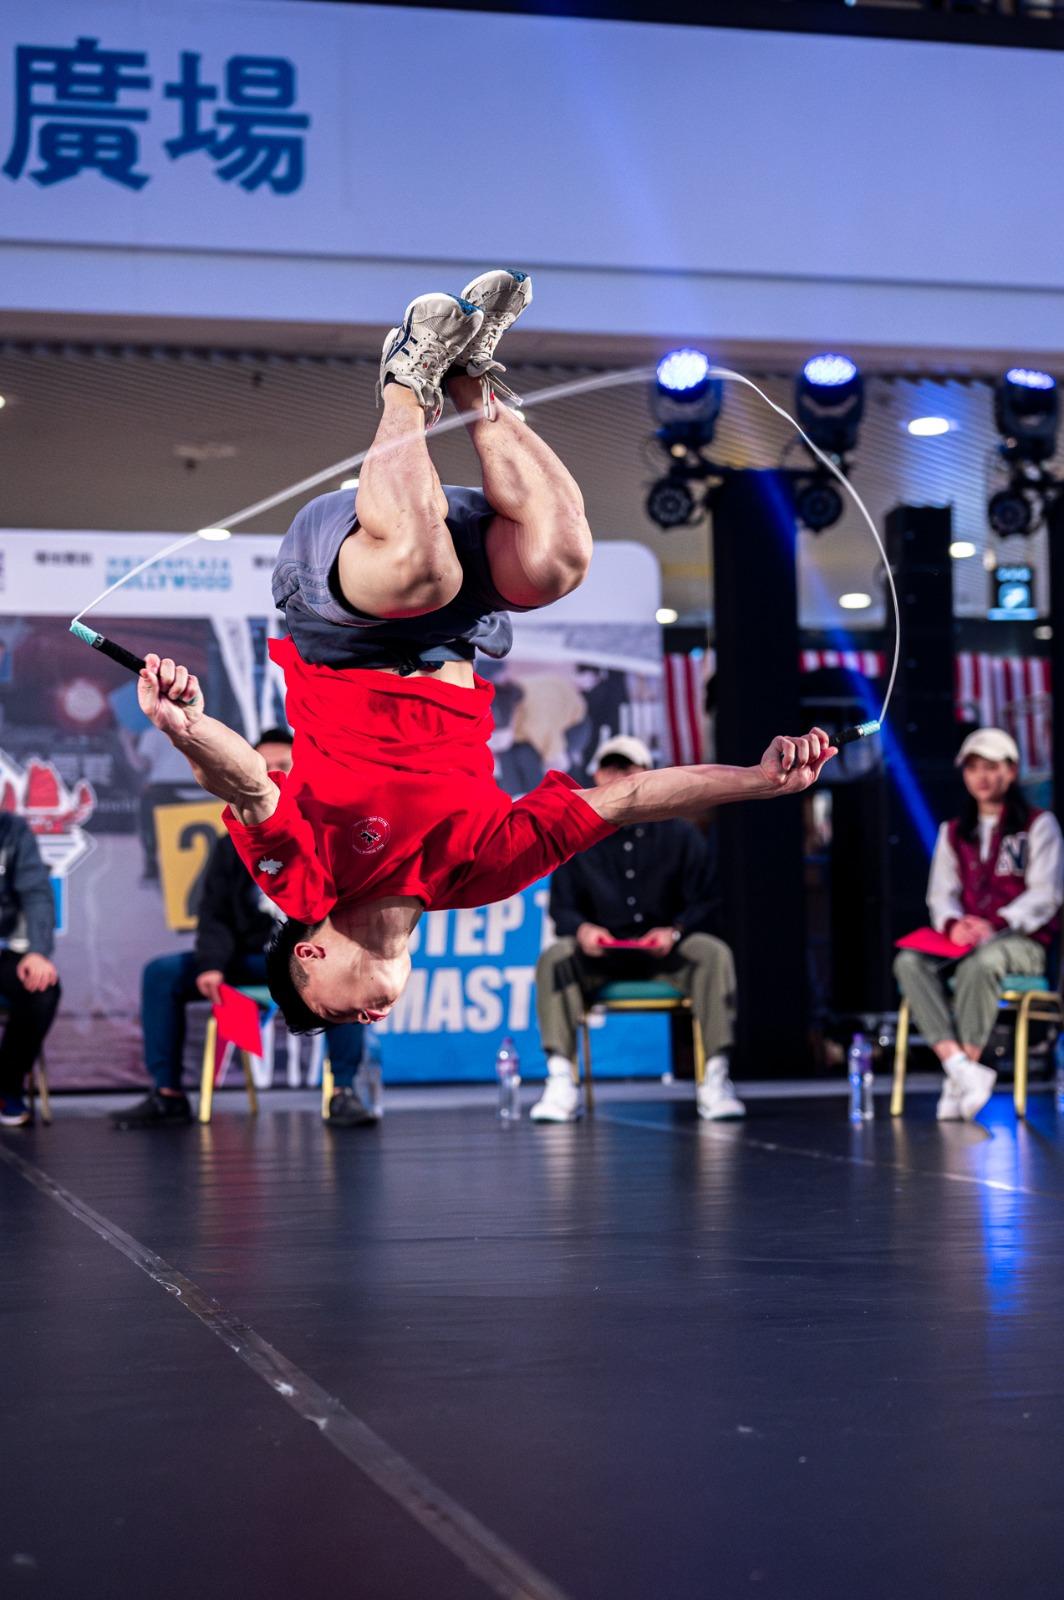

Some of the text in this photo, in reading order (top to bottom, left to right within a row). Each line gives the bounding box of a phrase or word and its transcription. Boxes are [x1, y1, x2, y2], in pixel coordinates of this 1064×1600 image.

[2, 37, 310, 195] 廣場
[406, 894, 525, 957] TEP
[372, 965, 537, 1034] MAST
